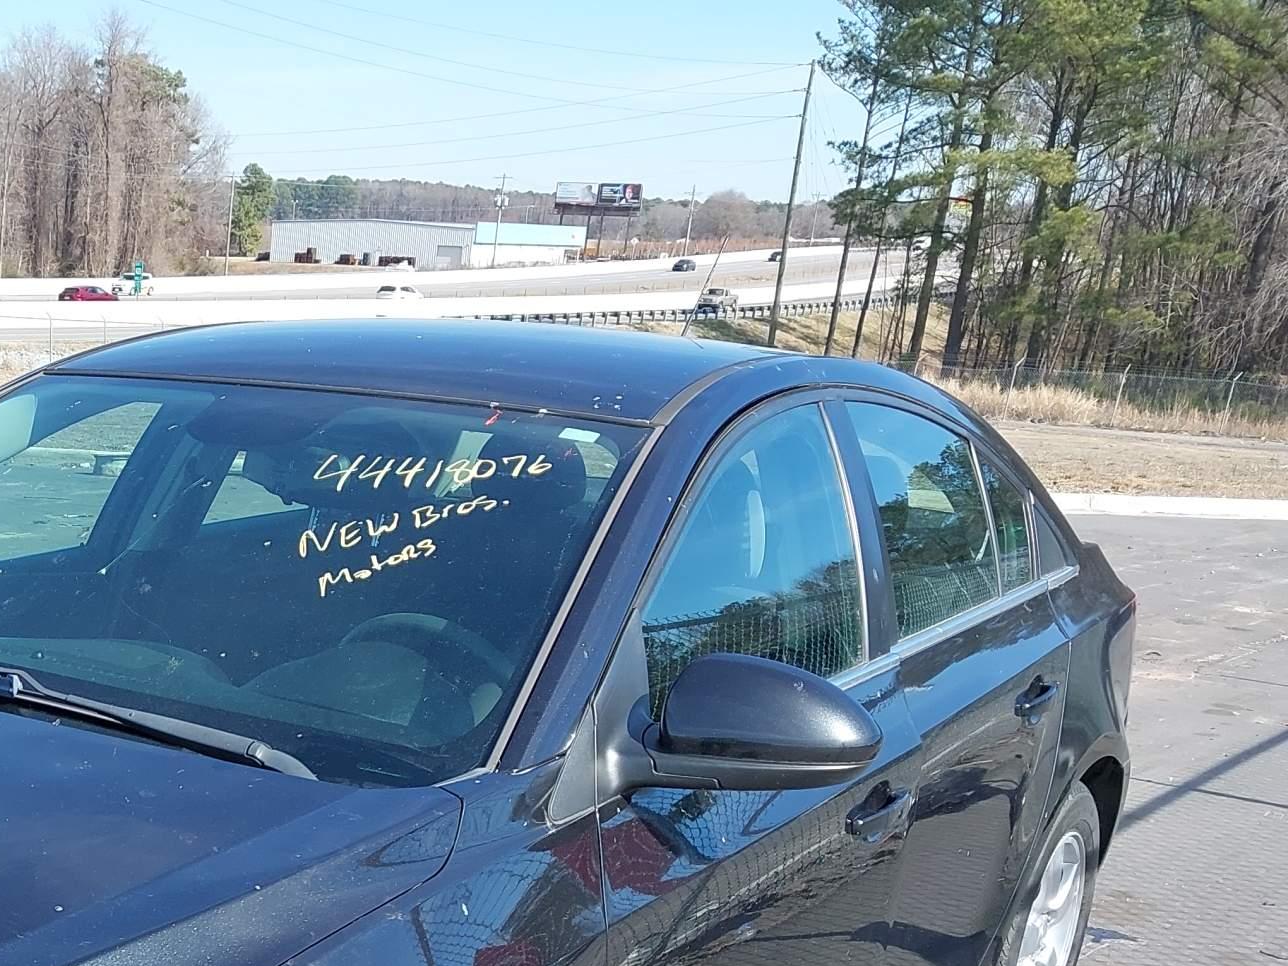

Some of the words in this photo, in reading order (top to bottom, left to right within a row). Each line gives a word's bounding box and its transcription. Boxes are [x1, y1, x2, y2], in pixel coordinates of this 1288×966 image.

[312, 453, 554, 492] 44418076
[298, 512, 400, 558] NEW
[412, 494, 510, 529] Bros.
